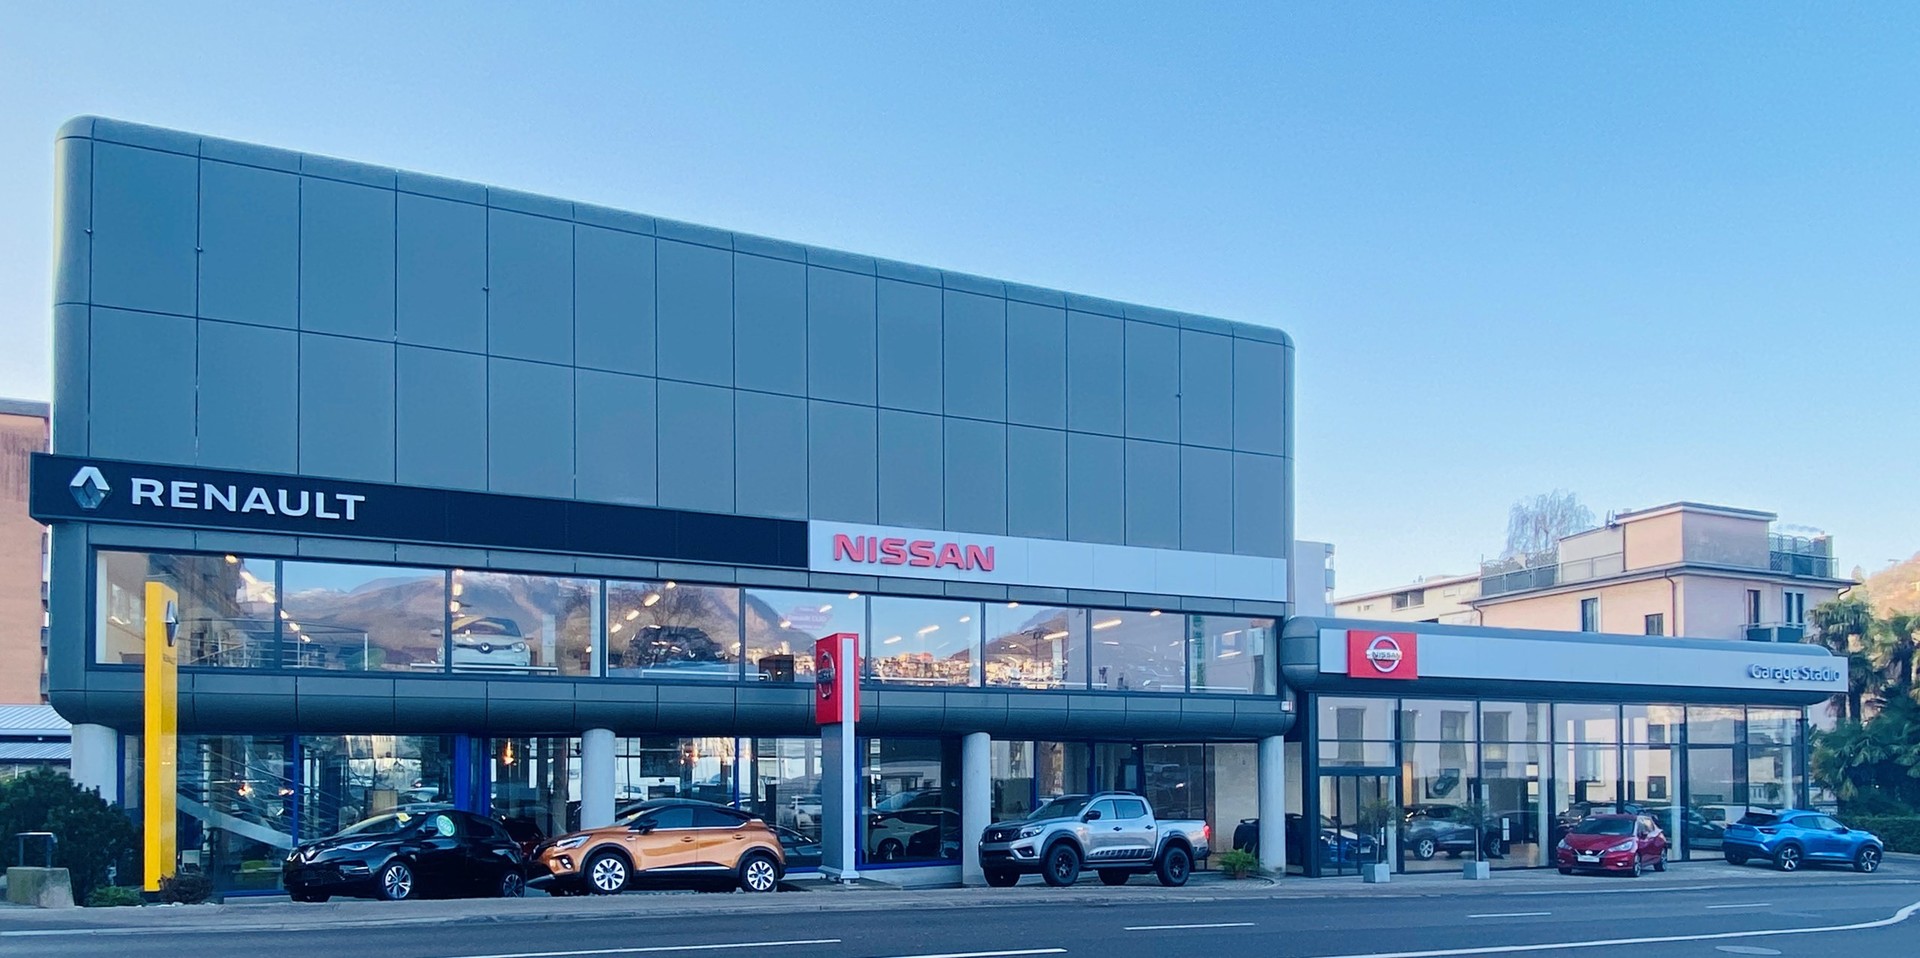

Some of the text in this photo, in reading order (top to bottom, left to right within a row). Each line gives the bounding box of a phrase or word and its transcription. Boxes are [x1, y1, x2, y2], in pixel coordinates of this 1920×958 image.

[131, 477, 365, 520] RENAULT
[833, 533, 994, 572] NISSAN
[1371, 651, 1401, 660] NISSAN
[1750, 663, 1841, 683] Garage Stadio
